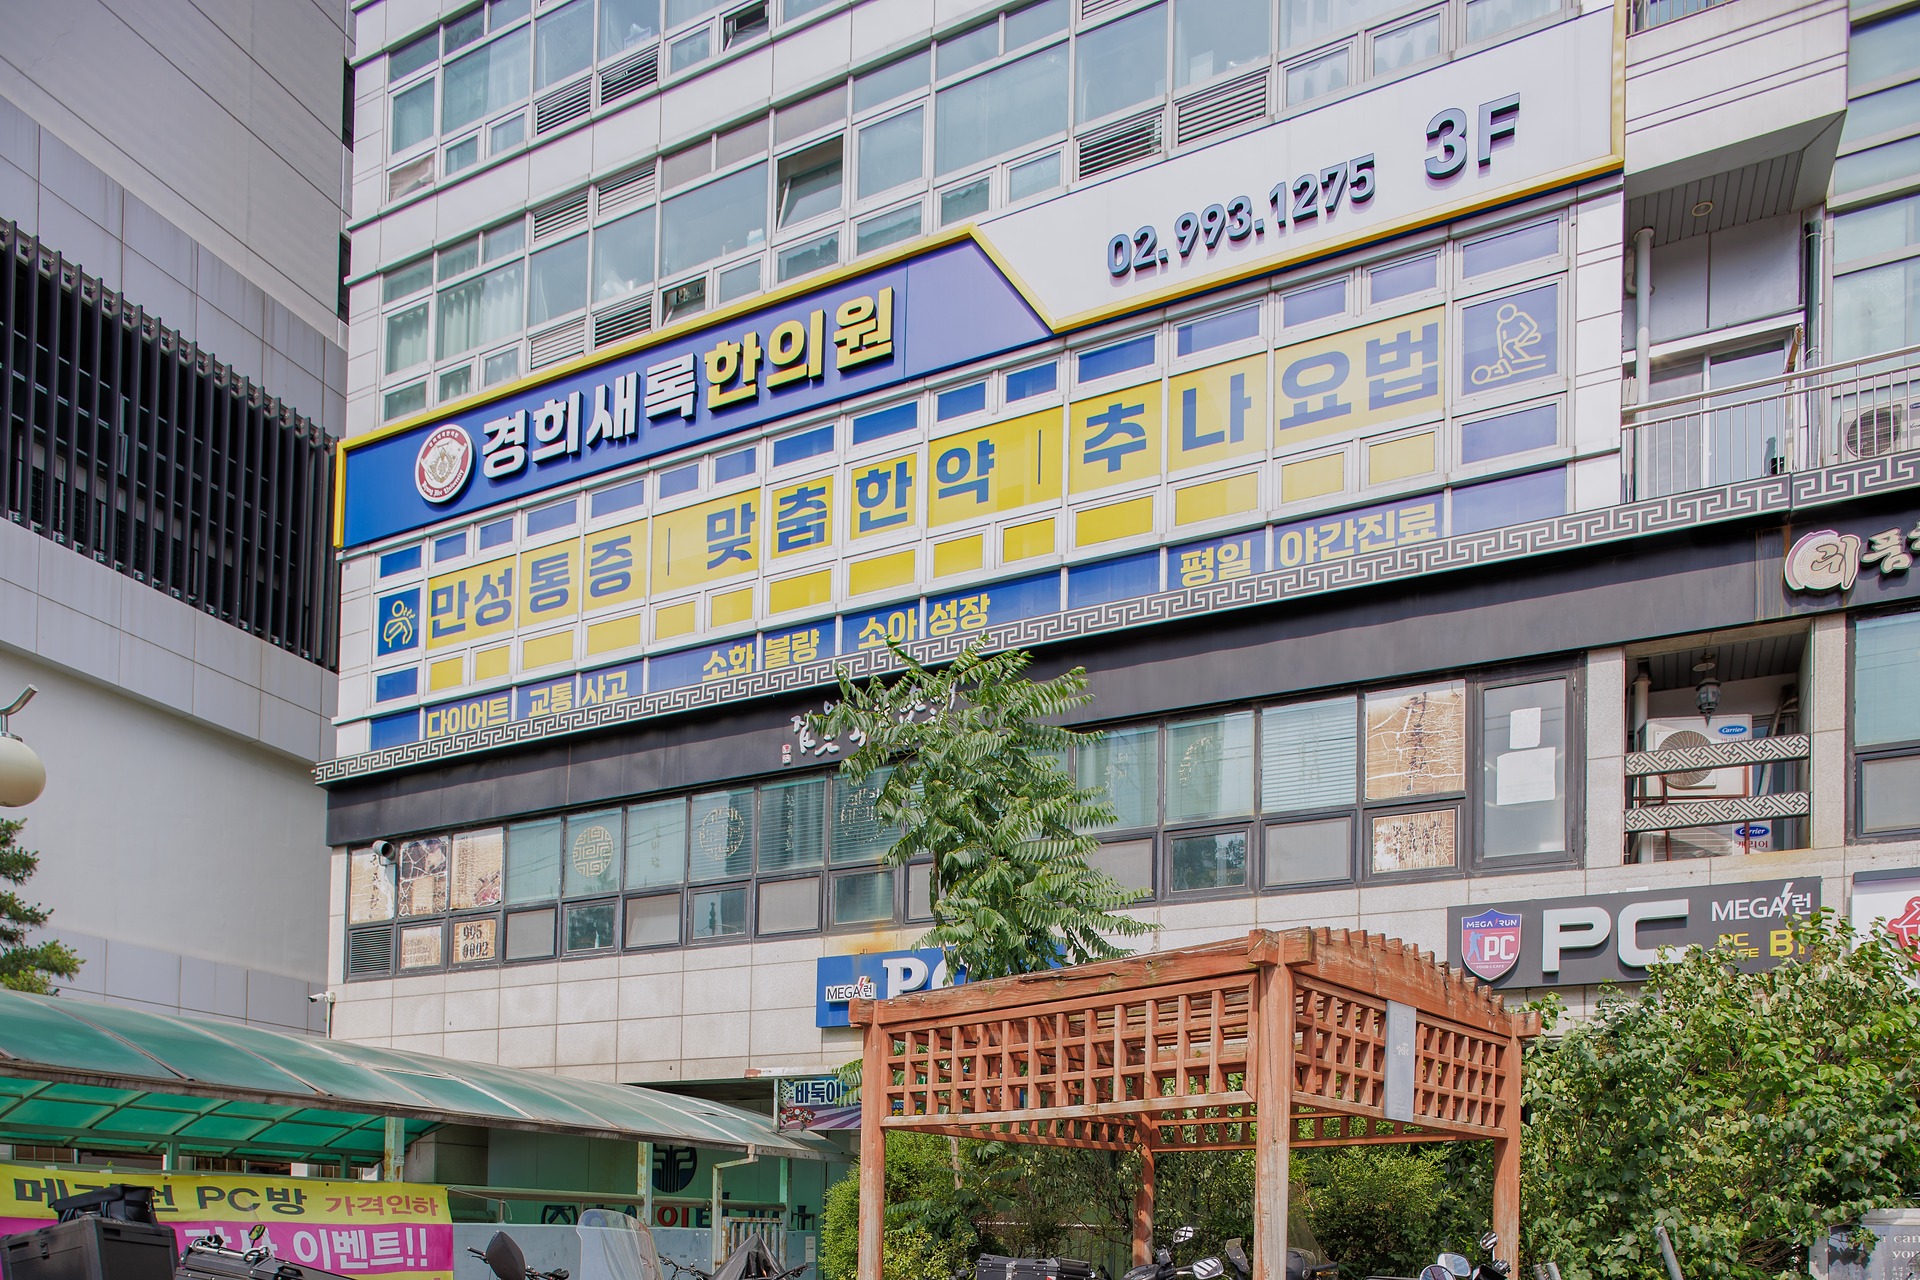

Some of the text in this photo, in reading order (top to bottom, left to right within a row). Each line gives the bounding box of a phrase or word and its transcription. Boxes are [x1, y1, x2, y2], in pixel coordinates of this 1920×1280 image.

[1108, 93, 1520, 276] 02.993.1275 3F
[427, 696, 508, 738] 다이어트
[1180, 540, 1251, 587] 평일
[1280, 503, 1437, 567] 야간진료
[1721, 726, 1744, 734] Carrier
[1739, 827, 1766, 835] Crrier
[1484, 935, 1515, 961] PC
[1541, 898, 1690, 974] PC
[196, 1186, 307, 1215] PC방
[325, 1195, 439, 1217] 가격인하
[293, 1227, 428, 1269] 이벤트!!
